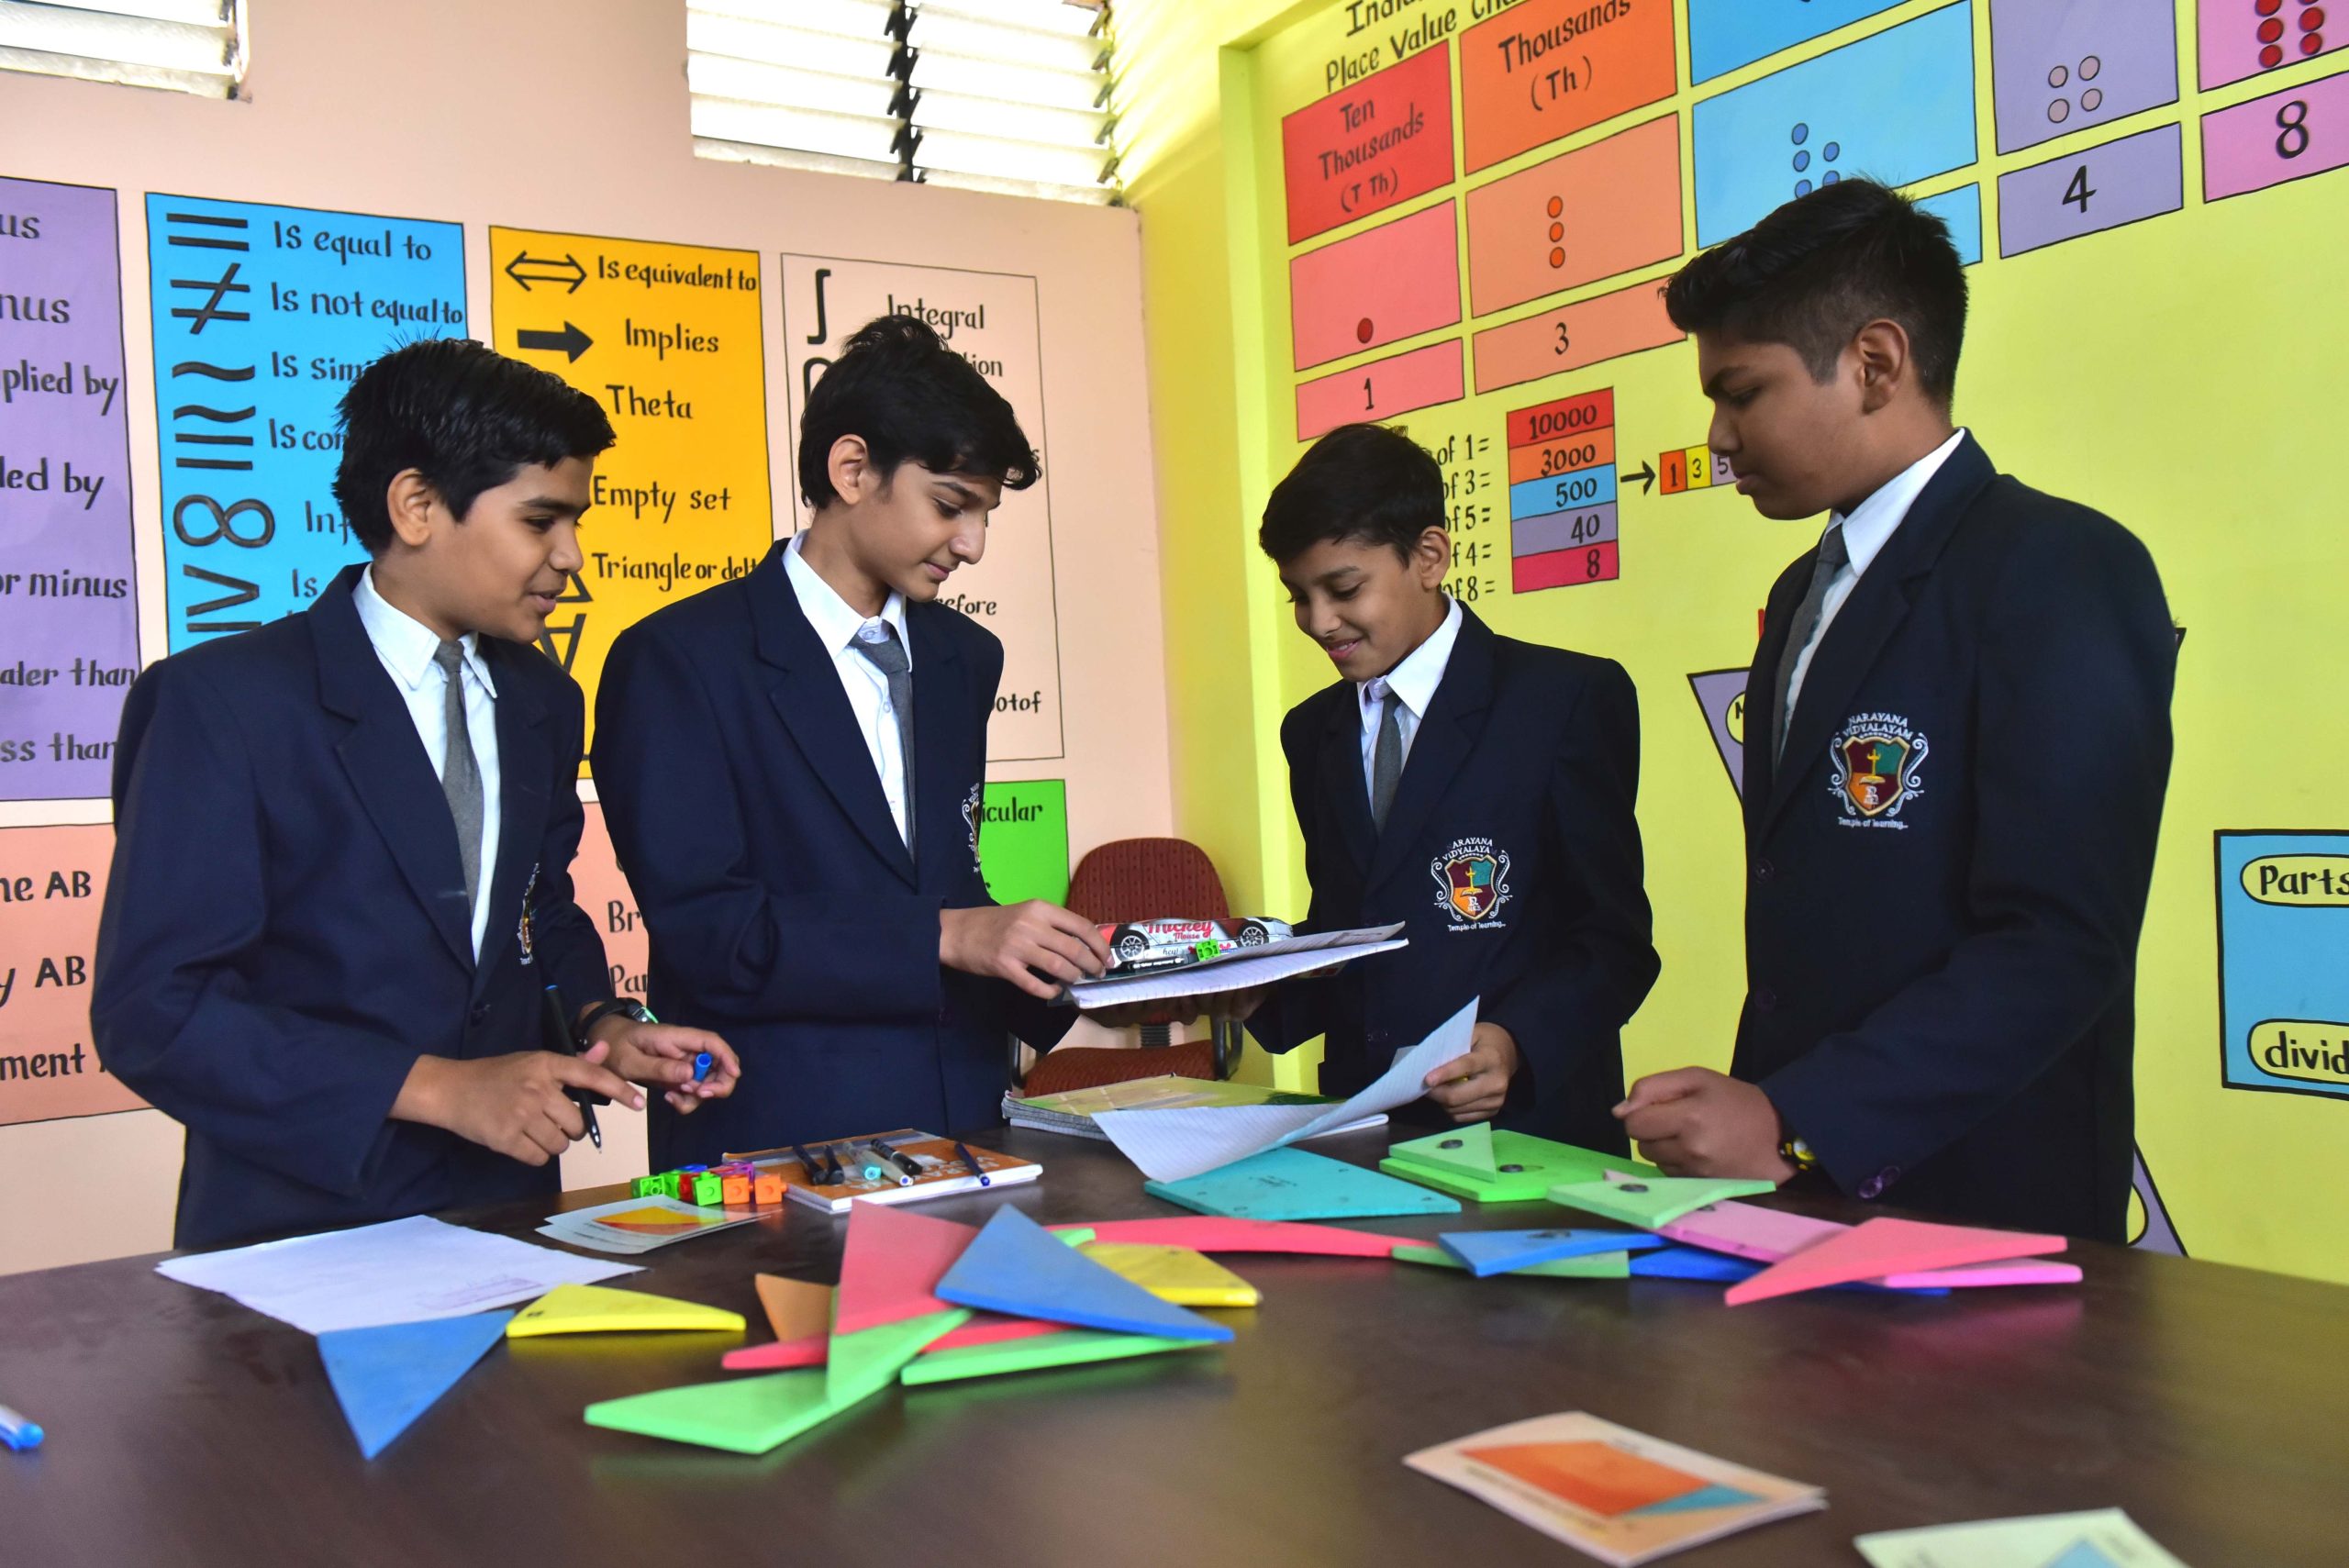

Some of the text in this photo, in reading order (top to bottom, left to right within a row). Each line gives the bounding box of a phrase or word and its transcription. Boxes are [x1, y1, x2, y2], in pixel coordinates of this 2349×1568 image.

[1326, 8, 1457, 93] Place Value
[1498, 0, 1631, 73] Thousands
[1340, 99, 1375, 133] Ten
[2276, 100, 2310, 159] 8
[1318, 102, 1424, 181] Thousands
[2061, 165, 2097, 213] 4
[274, 220, 431, 265] Is equal to
[598, 255, 757, 291] Is equivalent to
[271, 282, 463, 327] Is not equal to
[887, 294, 985, 340] Integral
[626, 318, 719, 361] Implies
[1554, 322, 1570, 355] 3
[272, 351, 298, 378] Is
[3, 359, 118, 416] plied by
[605, 384, 694, 419] Theta
[1364, 377, 1375, 410] 1
[269, 417, 296, 449] Is
[1529, 405, 1598, 440] 10000
[1437, 435, 1455, 466] of
[1541, 444, 1597, 477] 3000
[64, 462, 105, 510] by
[1670, 462, 1678, 488] 1
[1691, 457, 1702, 479] 3
[593, 475, 732, 524] Empty set
[1555, 478, 1598, 507] 500
[1570, 514, 1600, 544] 40
[592, 552, 692, 592] Triangle
[696, 564, 718, 580] or
[1586, 549, 1600, 578] 8
[28, 569, 128, 598] minus
[69, 657, 135, 687] than
[1842, 722, 1914, 740] VIDYALAYAM
[1847, 712, 1909, 728] NARAYANA
[1442, 845, 1491, 862] VIDYALAYA
[1452, 837, 1493, 850] ARAYANA
[45, 871, 92, 898] AB
[2259, 865, 2349, 896] Parts
[35, 957, 87, 987] AB
[0, 1042, 86, 1081] ment
[2265, 1030, 2349, 1074] divid
